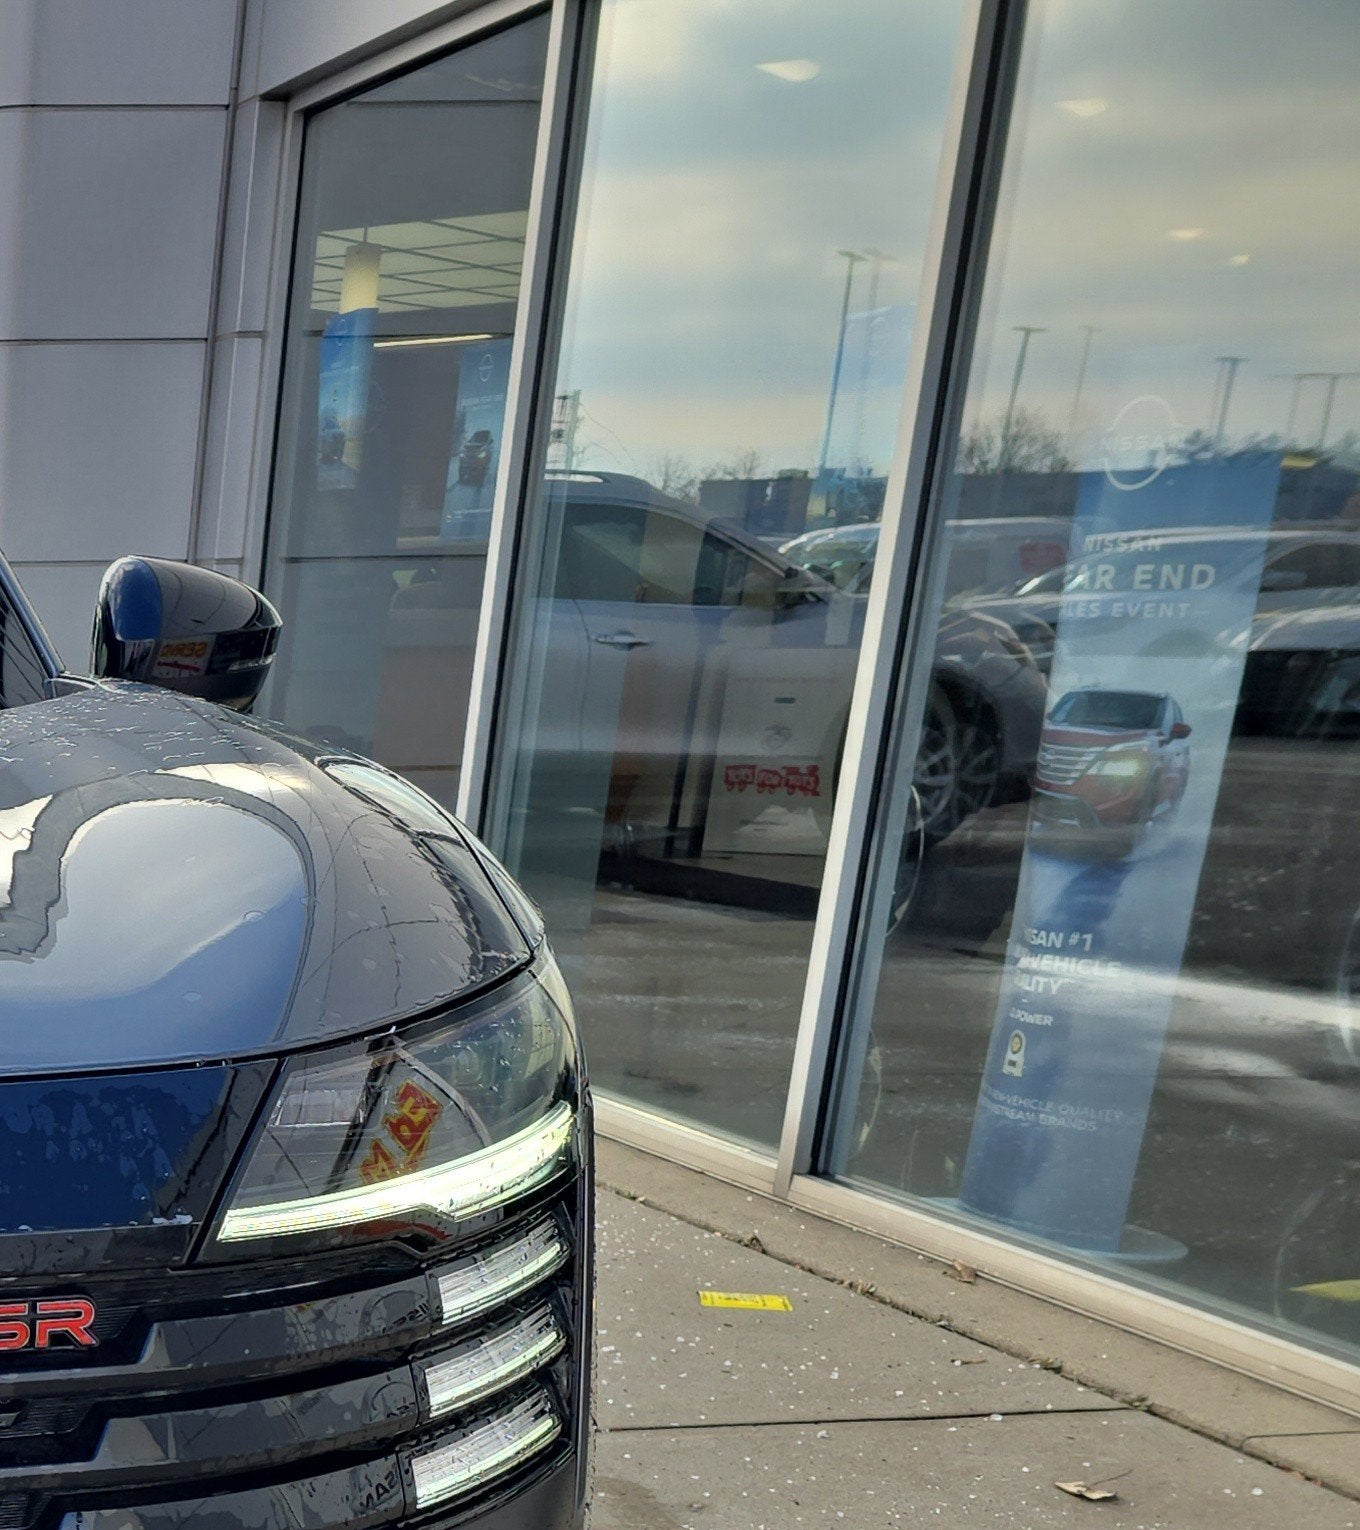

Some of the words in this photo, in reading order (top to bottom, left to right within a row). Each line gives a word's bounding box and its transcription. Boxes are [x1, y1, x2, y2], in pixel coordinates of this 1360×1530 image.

[1133, 563, 1216, 590] END
[1111, 602, 1192, 618] EVENT
[1068, 931, 1093, 952] #1
